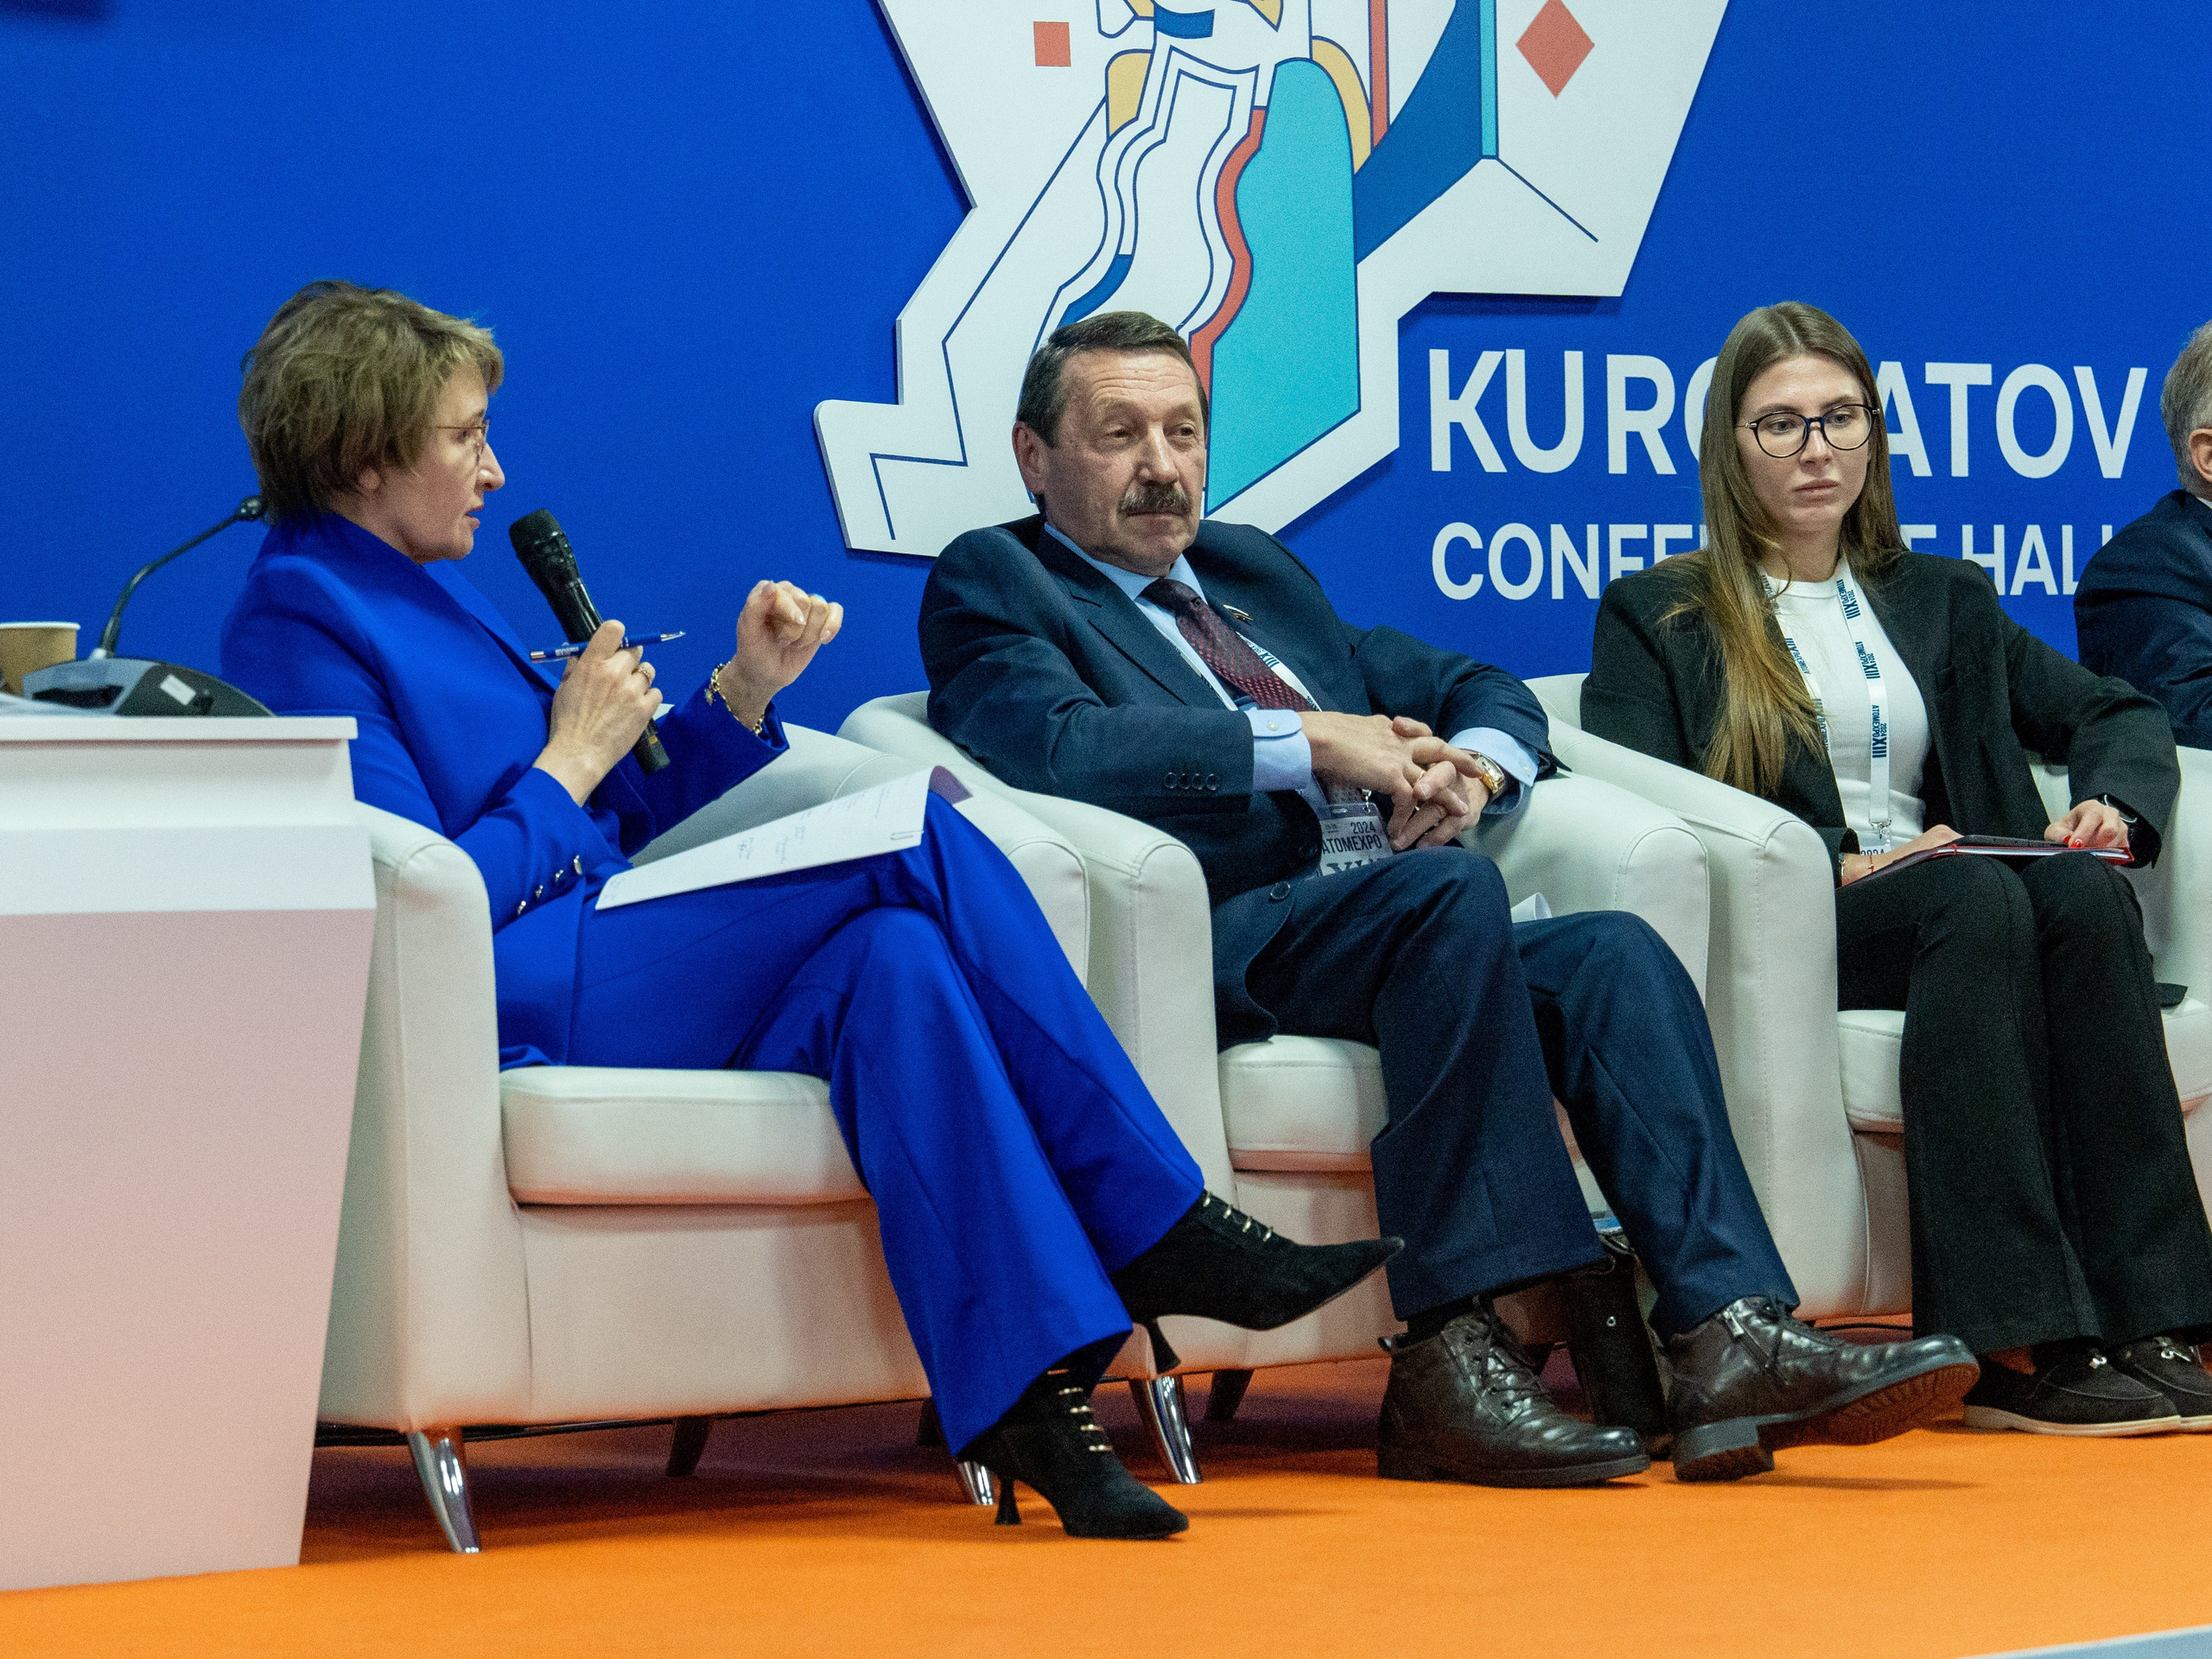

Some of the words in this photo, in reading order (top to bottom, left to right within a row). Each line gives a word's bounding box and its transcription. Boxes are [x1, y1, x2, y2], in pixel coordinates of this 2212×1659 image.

[1429, 348, 2148, 479] KURATOV
[1843, 600, 1861, 620] XIII
[1862, 663, 1881, 679] XIII
[1872, 704, 1880, 737] ATOMEXPO
[1872, 736, 1887, 758] XIII
[1351, 821, 1376, 834] 2024
[1322, 834, 1382, 855] ATOMEXPO
